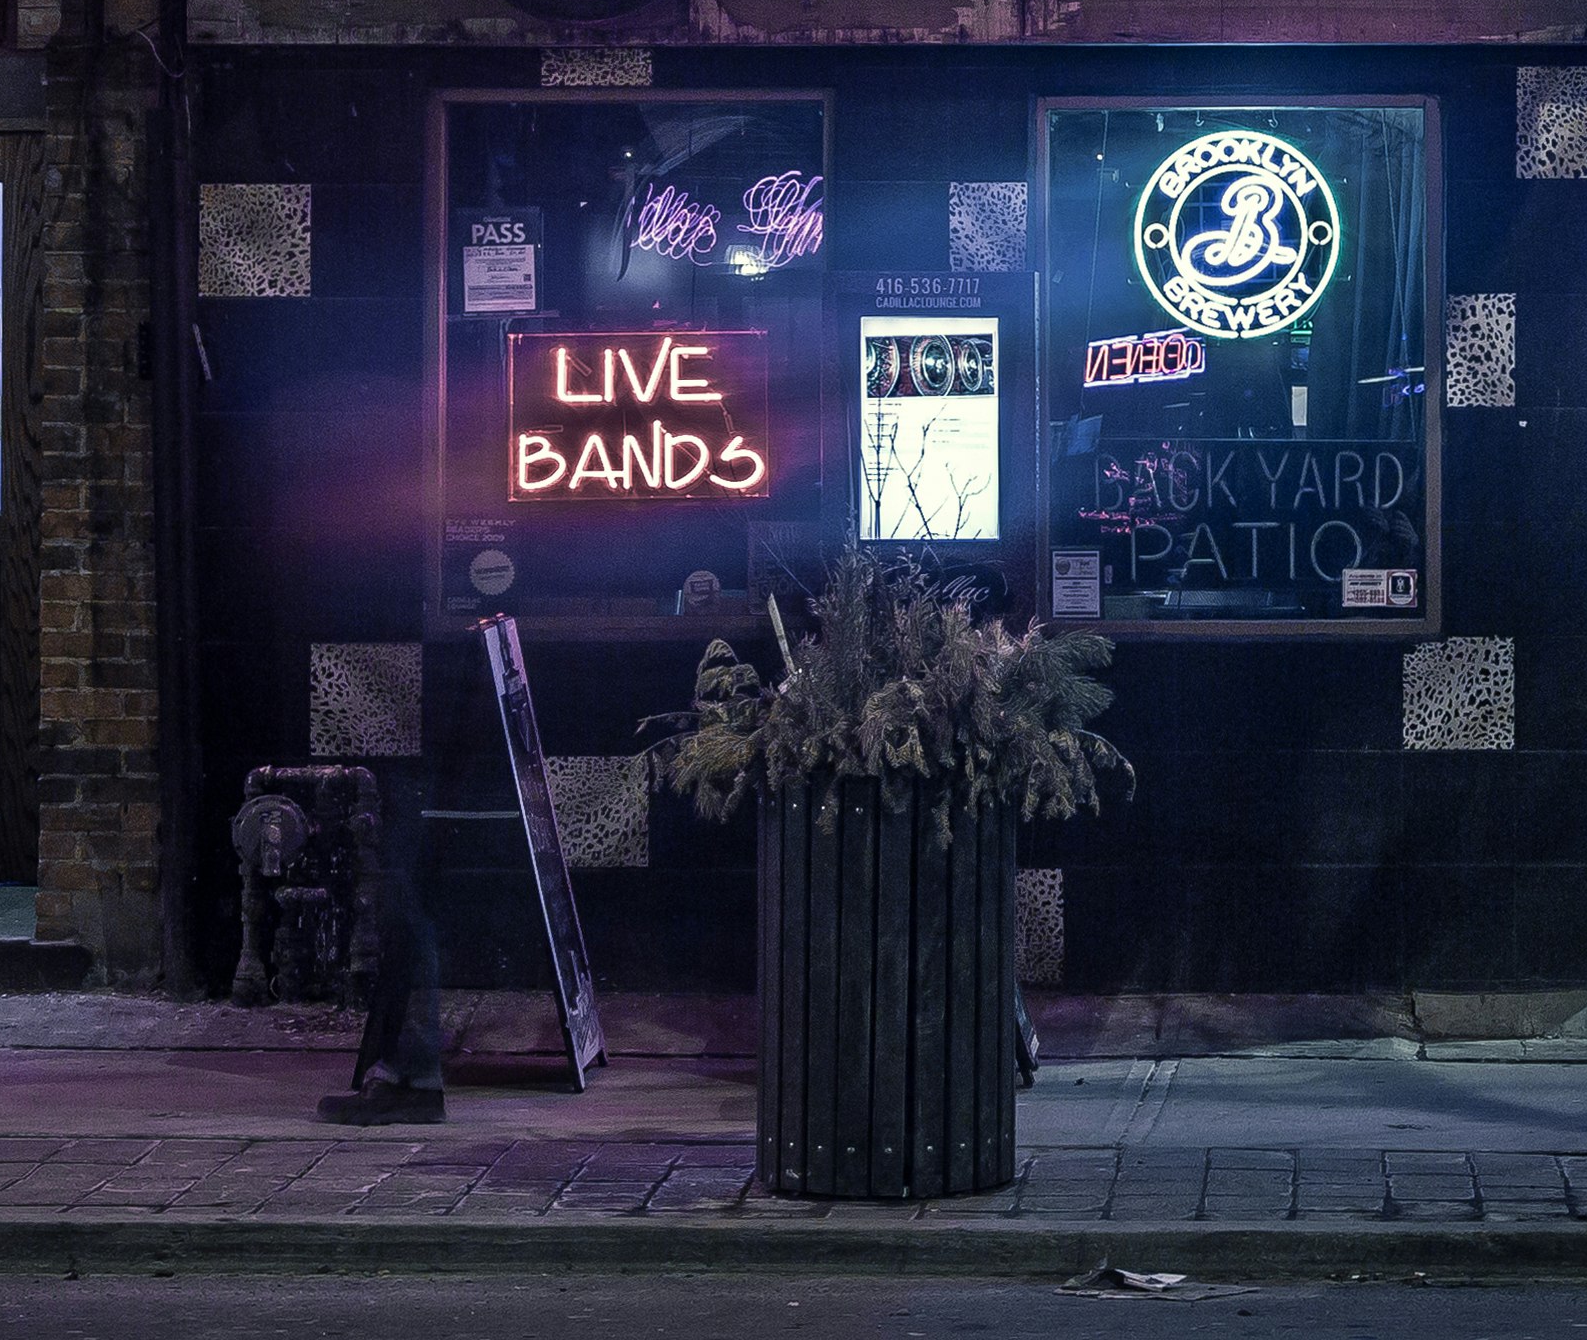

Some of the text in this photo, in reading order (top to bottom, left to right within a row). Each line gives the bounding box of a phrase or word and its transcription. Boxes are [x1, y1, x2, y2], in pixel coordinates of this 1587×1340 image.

[1158, 138, 1317, 199] BROOKLYN
[471, 223, 526, 244] PASS
[875, 277, 980, 294] 416-536-7717
[875, 297, 981, 308] CADILLACLOUNGE.COM
[1163, 272, 1314, 331] BREWERY
[555, 337, 723, 403] LIVE
[517, 420, 766, 490] BANDS
[1257, 450, 1403, 511] YARD
[1131, 519, 1362, 582] PATIO
